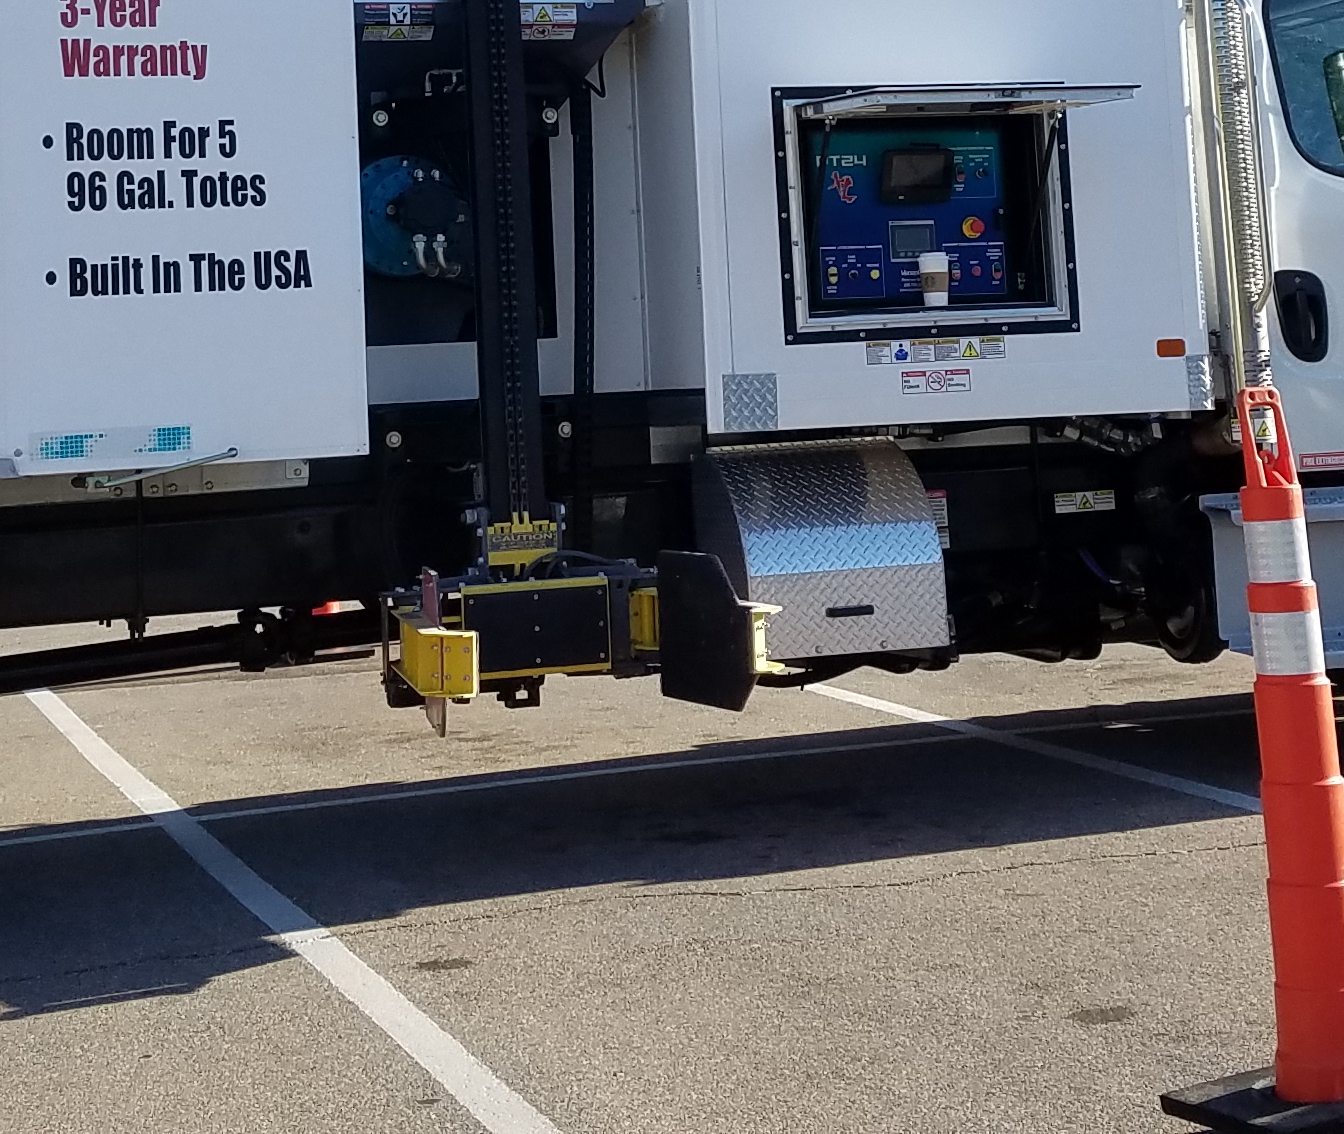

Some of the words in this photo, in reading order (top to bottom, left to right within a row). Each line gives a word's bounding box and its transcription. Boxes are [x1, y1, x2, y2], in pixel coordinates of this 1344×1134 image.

[59, 38, 208, 80] Warranty
[65, 122, 155, 161] Room
[163, 120, 211, 159] For
[218, 119, 238, 159] 5
[66, 171, 108, 212] 96
[116, 170, 174, 210] Gal.
[181, 169, 267, 208] Totes
[68, 256, 145, 297] Built
[152, 254, 182, 294] In
[189, 252, 246, 292] The
[254, 249, 313, 290] USA
[492, 533, 553, 543] CAUTION
